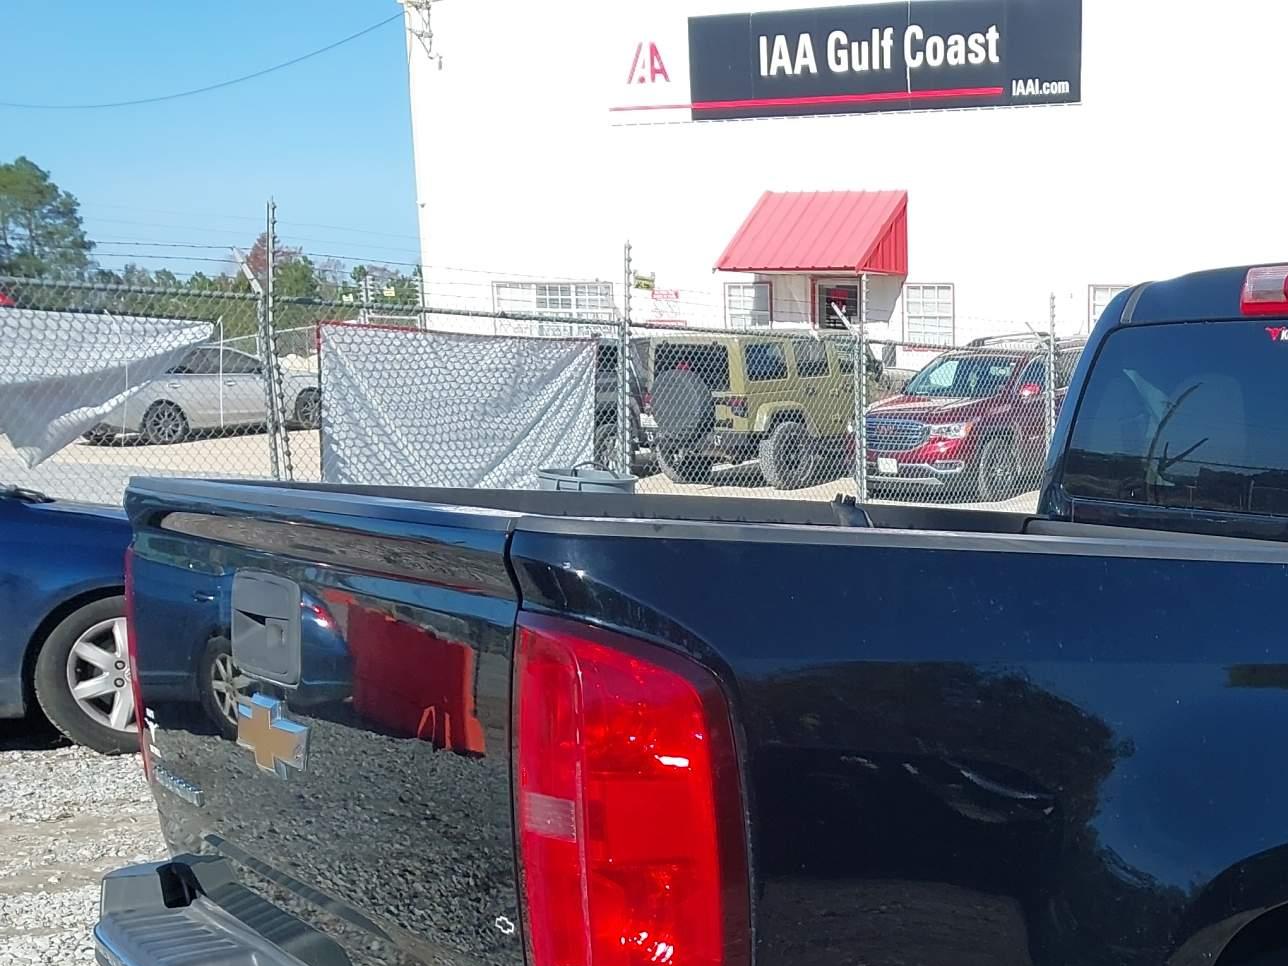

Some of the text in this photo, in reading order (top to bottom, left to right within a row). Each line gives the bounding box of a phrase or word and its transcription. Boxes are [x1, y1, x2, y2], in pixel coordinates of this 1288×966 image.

[759, 24, 1000, 76] IAA Gulf Coast
[1012, 78, 1070, 97] IAAI.com
